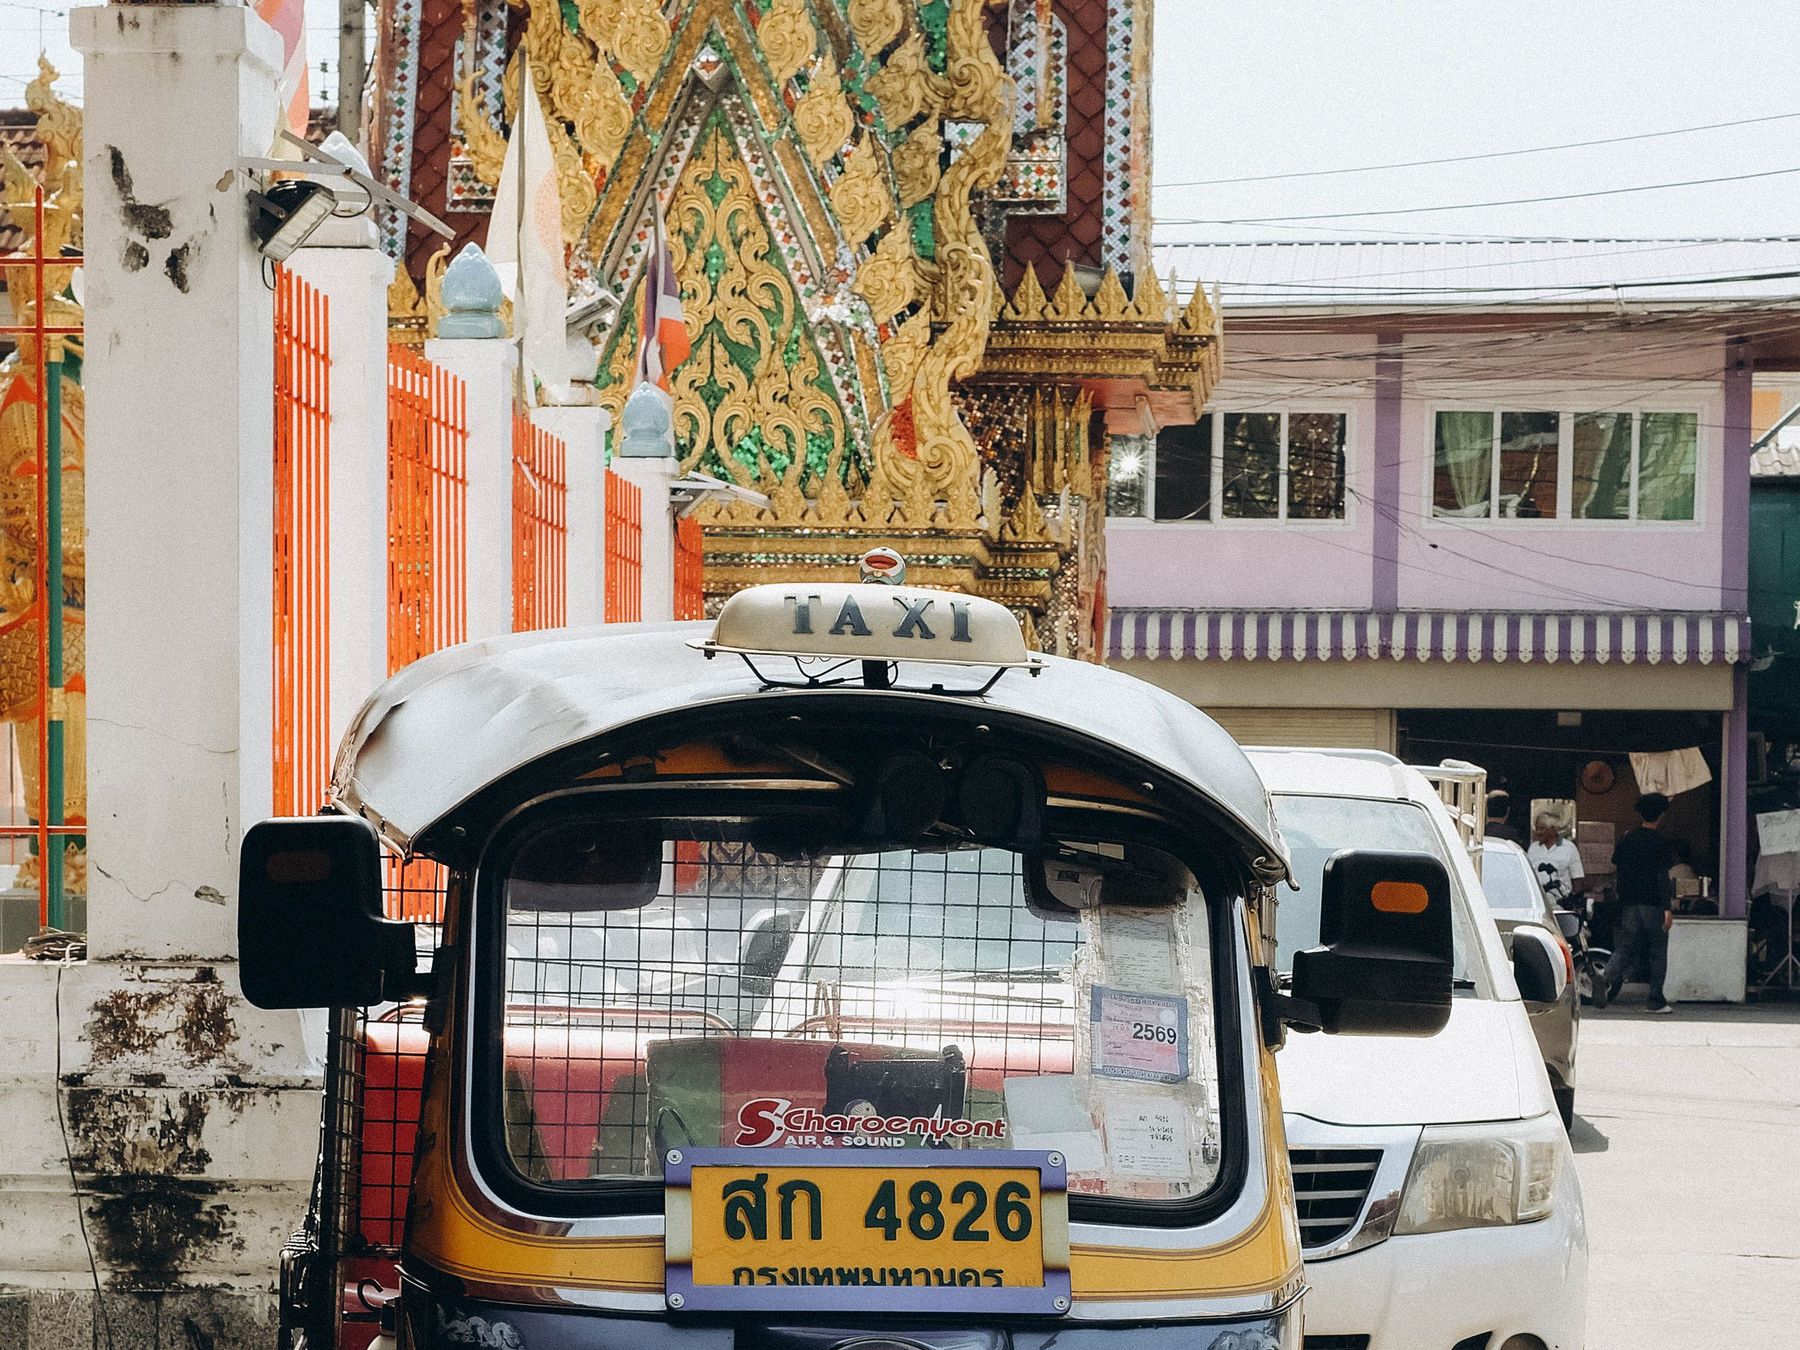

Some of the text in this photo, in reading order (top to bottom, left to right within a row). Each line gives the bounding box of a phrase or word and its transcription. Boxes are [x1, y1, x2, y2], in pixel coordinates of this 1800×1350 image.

[783, 593, 973, 643] TAXI
[1132, 1022, 1177, 1045] 2569
[784, 1134, 906, 1148] AIR & SOUND
[722, 1173, 1033, 1242] สก 4826
[732, 1266, 1005, 1287] กรงเทพมหานคร
